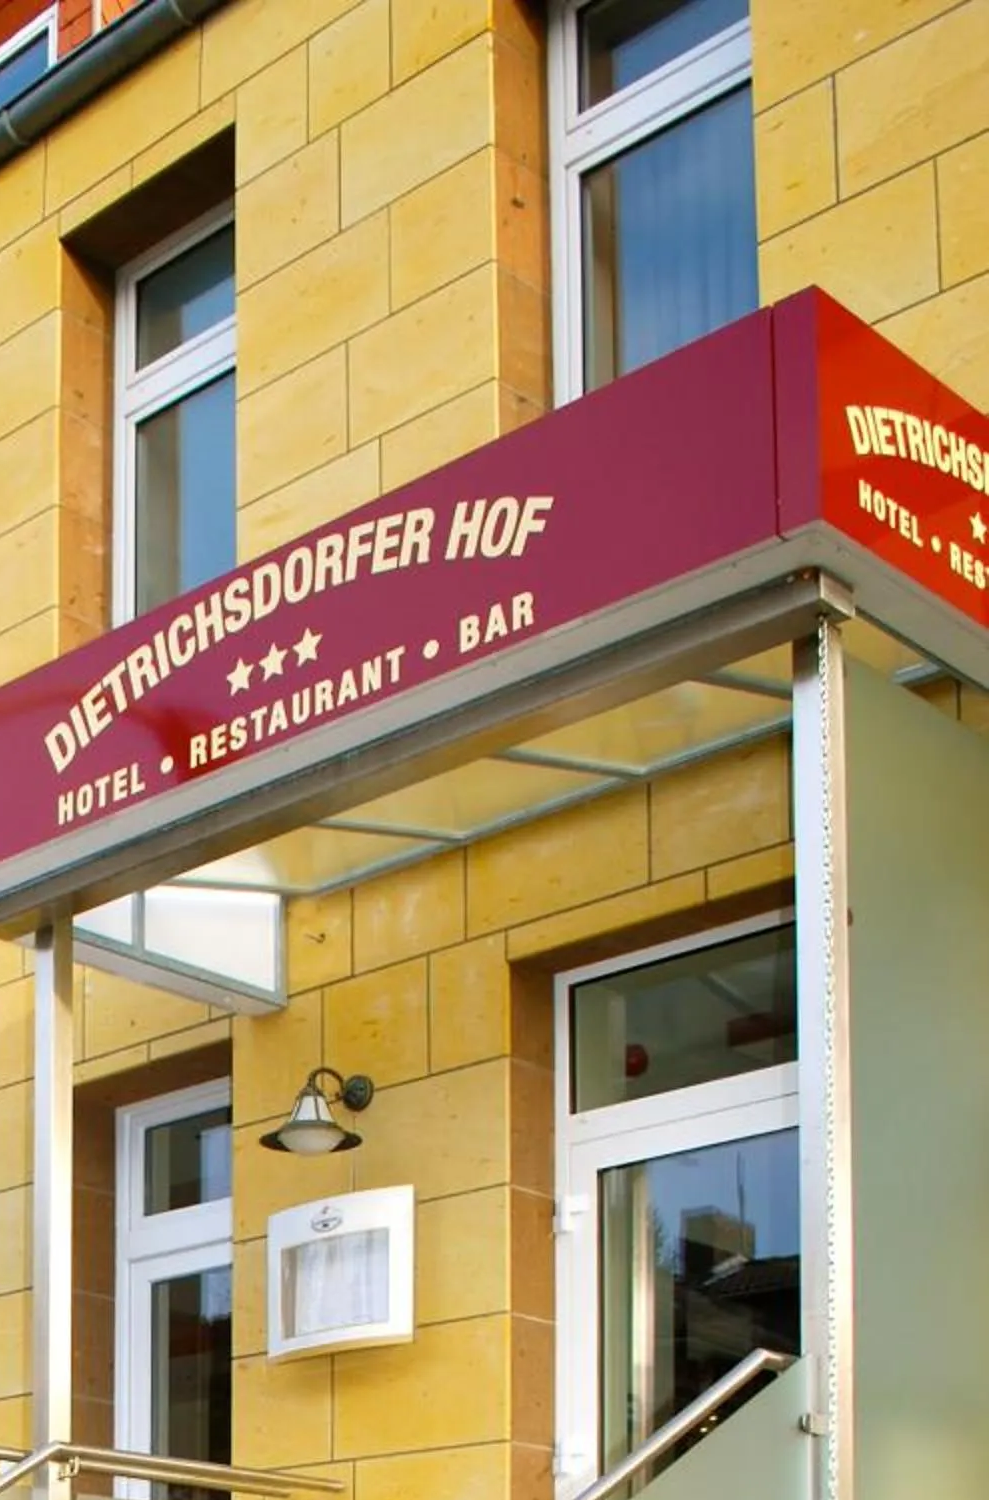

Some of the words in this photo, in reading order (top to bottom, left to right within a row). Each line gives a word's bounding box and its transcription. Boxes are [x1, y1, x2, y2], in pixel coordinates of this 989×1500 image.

[846, 405, 989, 496] DIETRICHS
[858, 479, 924, 548] HOTEL
[949, 541, 989, 590] RES
[45, 506, 435, 774] DIETRICHSDORFER
[444, 496, 554, 560] HOF
[57, 763, 146, 825] HOTEL
[190, 647, 405, 769] RESTAURANT
[459, 591, 534, 653] BAR
